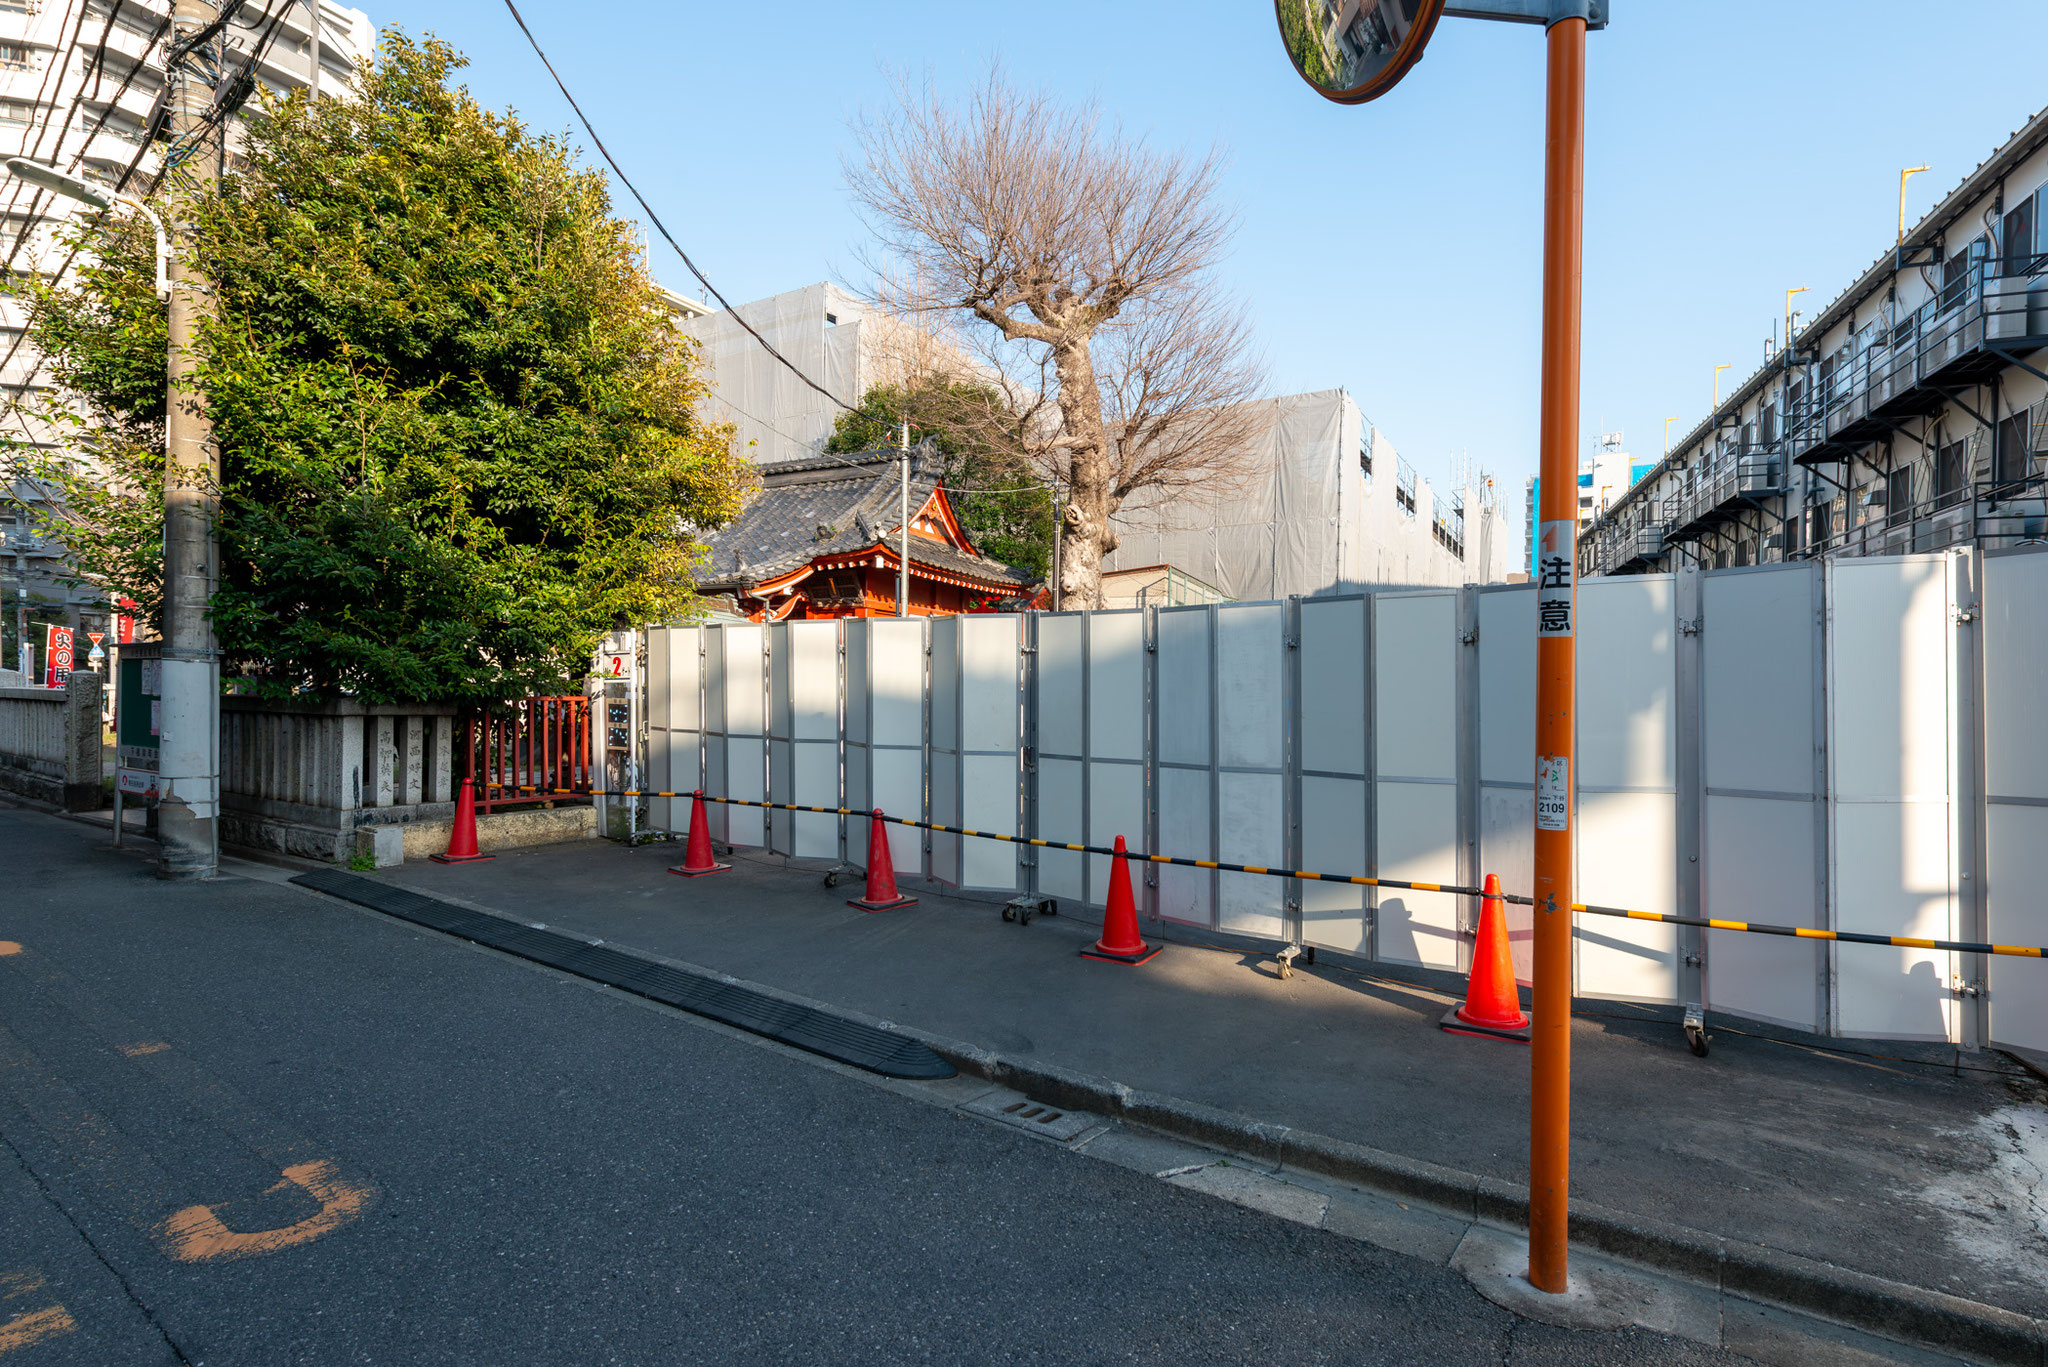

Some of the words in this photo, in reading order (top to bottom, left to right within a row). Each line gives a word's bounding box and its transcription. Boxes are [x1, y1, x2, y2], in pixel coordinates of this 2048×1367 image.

[1540, 556, 1571, 632] 注意
[54, 632, 72, 688] 火の用
[612, 656, 621, 677] 2
[1539, 802, 1565, 814] 2109
